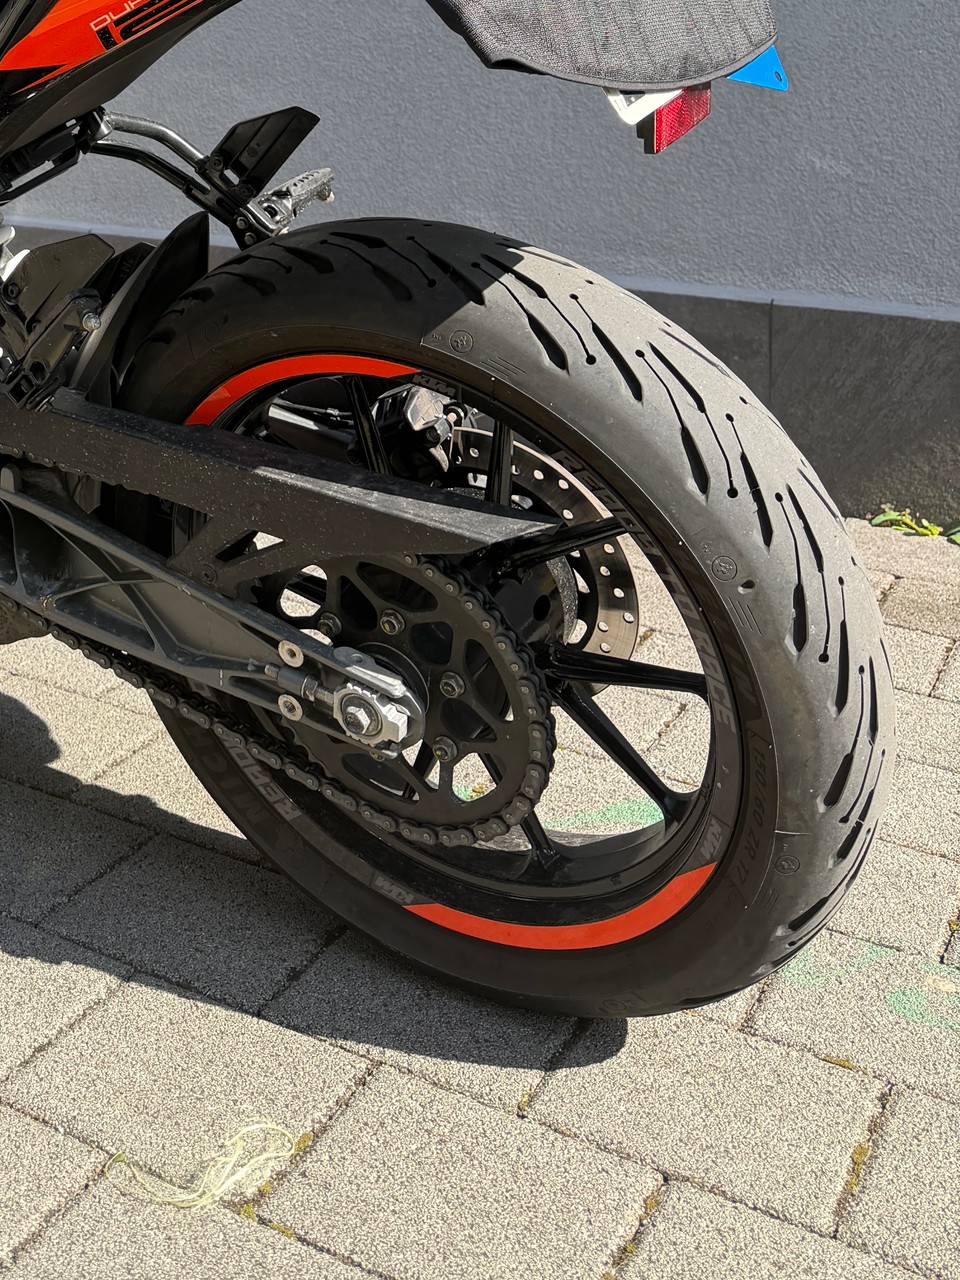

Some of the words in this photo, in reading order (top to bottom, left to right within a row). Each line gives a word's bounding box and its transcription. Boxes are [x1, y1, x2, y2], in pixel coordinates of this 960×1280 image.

[412, 374, 456, 397] KTM
[553, 449, 658, 556] READY
[659, 564, 700, 618] TO
[689, 627, 737, 734] RACE
